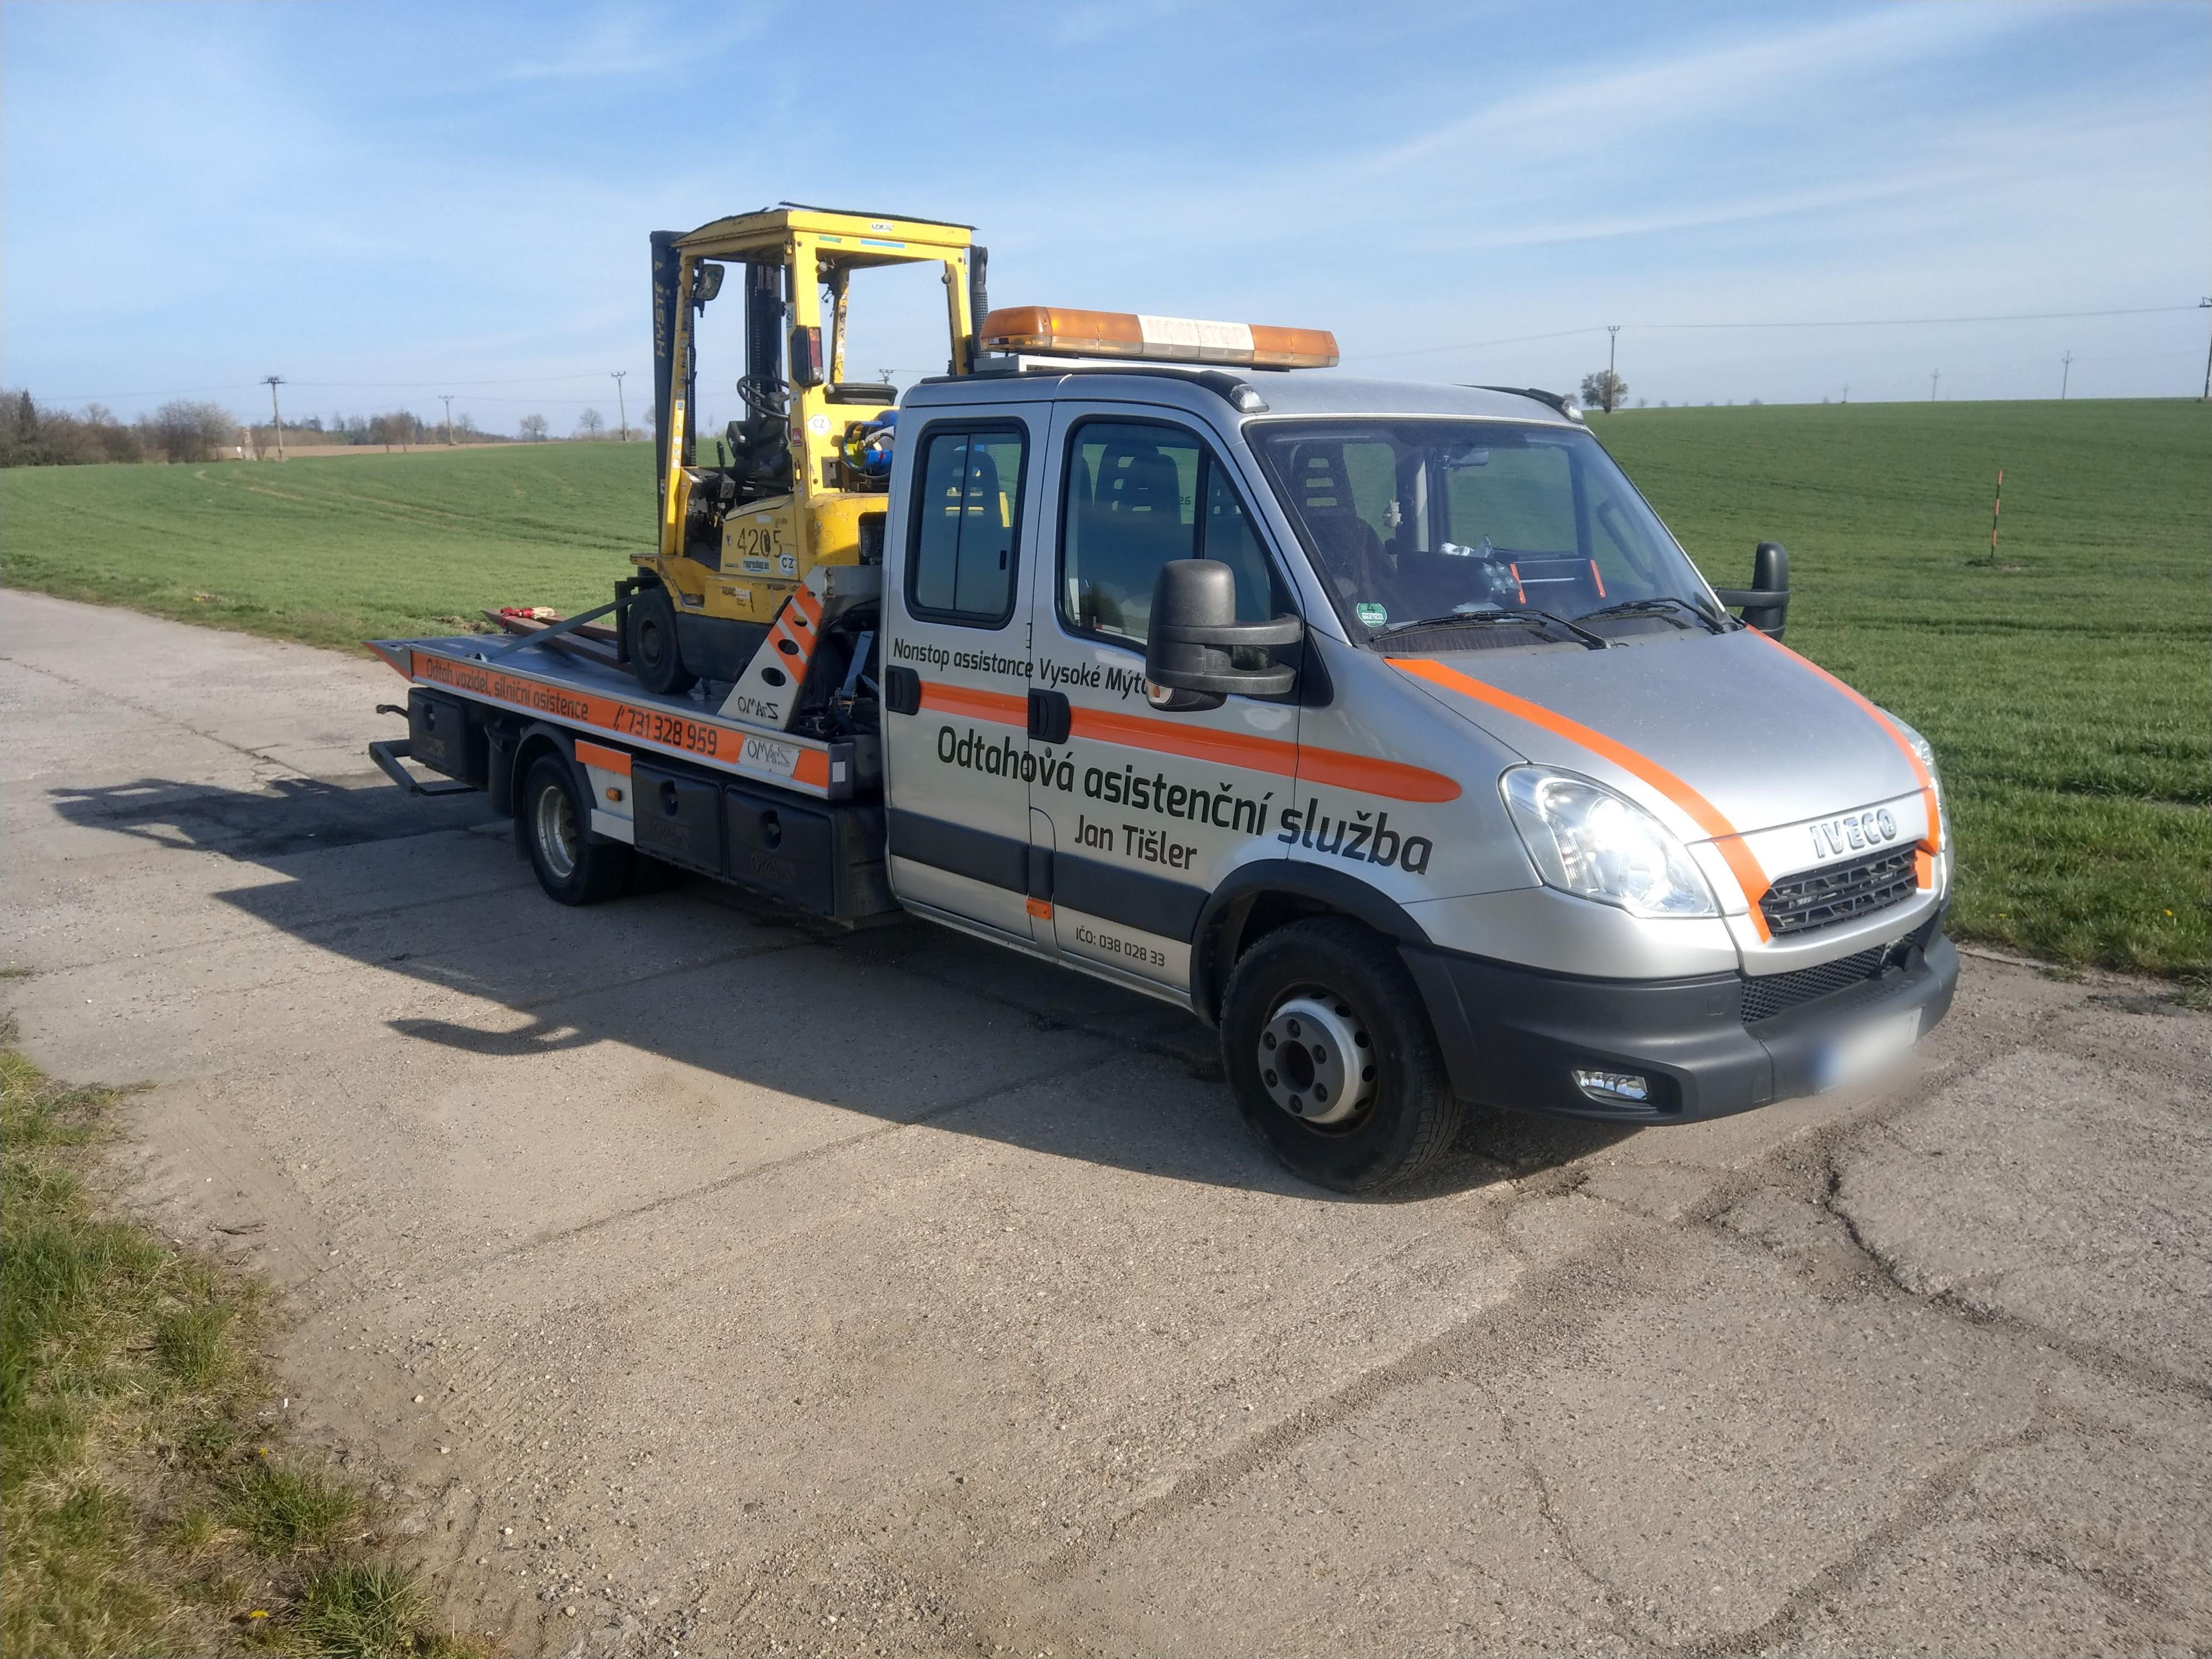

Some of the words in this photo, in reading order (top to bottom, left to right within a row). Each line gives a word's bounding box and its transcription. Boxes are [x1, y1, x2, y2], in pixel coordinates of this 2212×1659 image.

[813, 419, 825, 429] CZ
[737, 528, 783, 558] 4205
[781, 557, 794, 569] CZ
[894, 638, 950, 672] Nonstop
[954, 650, 1034, 678] assistance
[1040, 658, 1100, 688] Vysoké
[456, 671, 491, 697] vozidel,
[494, 675, 531, 705] silniční
[534, 688, 589, 721] asistence
[628, 708, 650, 737] 731
[654, 715, 682, 746] 328
[687, 724, 717, 755] 959
[938, 726, 1074, 792] Odtahová
[1084, 764, 1274, 836] asistenční
[1277, 798, 1433, 875] služba
[1074, 815, 1114, 852] Jan
[1123, 824, 1197, 870] Tišler
[1810, 808, 1897, 859] IVECO
[1076, 925, 1096, 945] IČO:
[1099, 934, 1121, 953] 038
[1124, 942, 1147, 961] 028
[1150, 950, 1165, 967] 33
